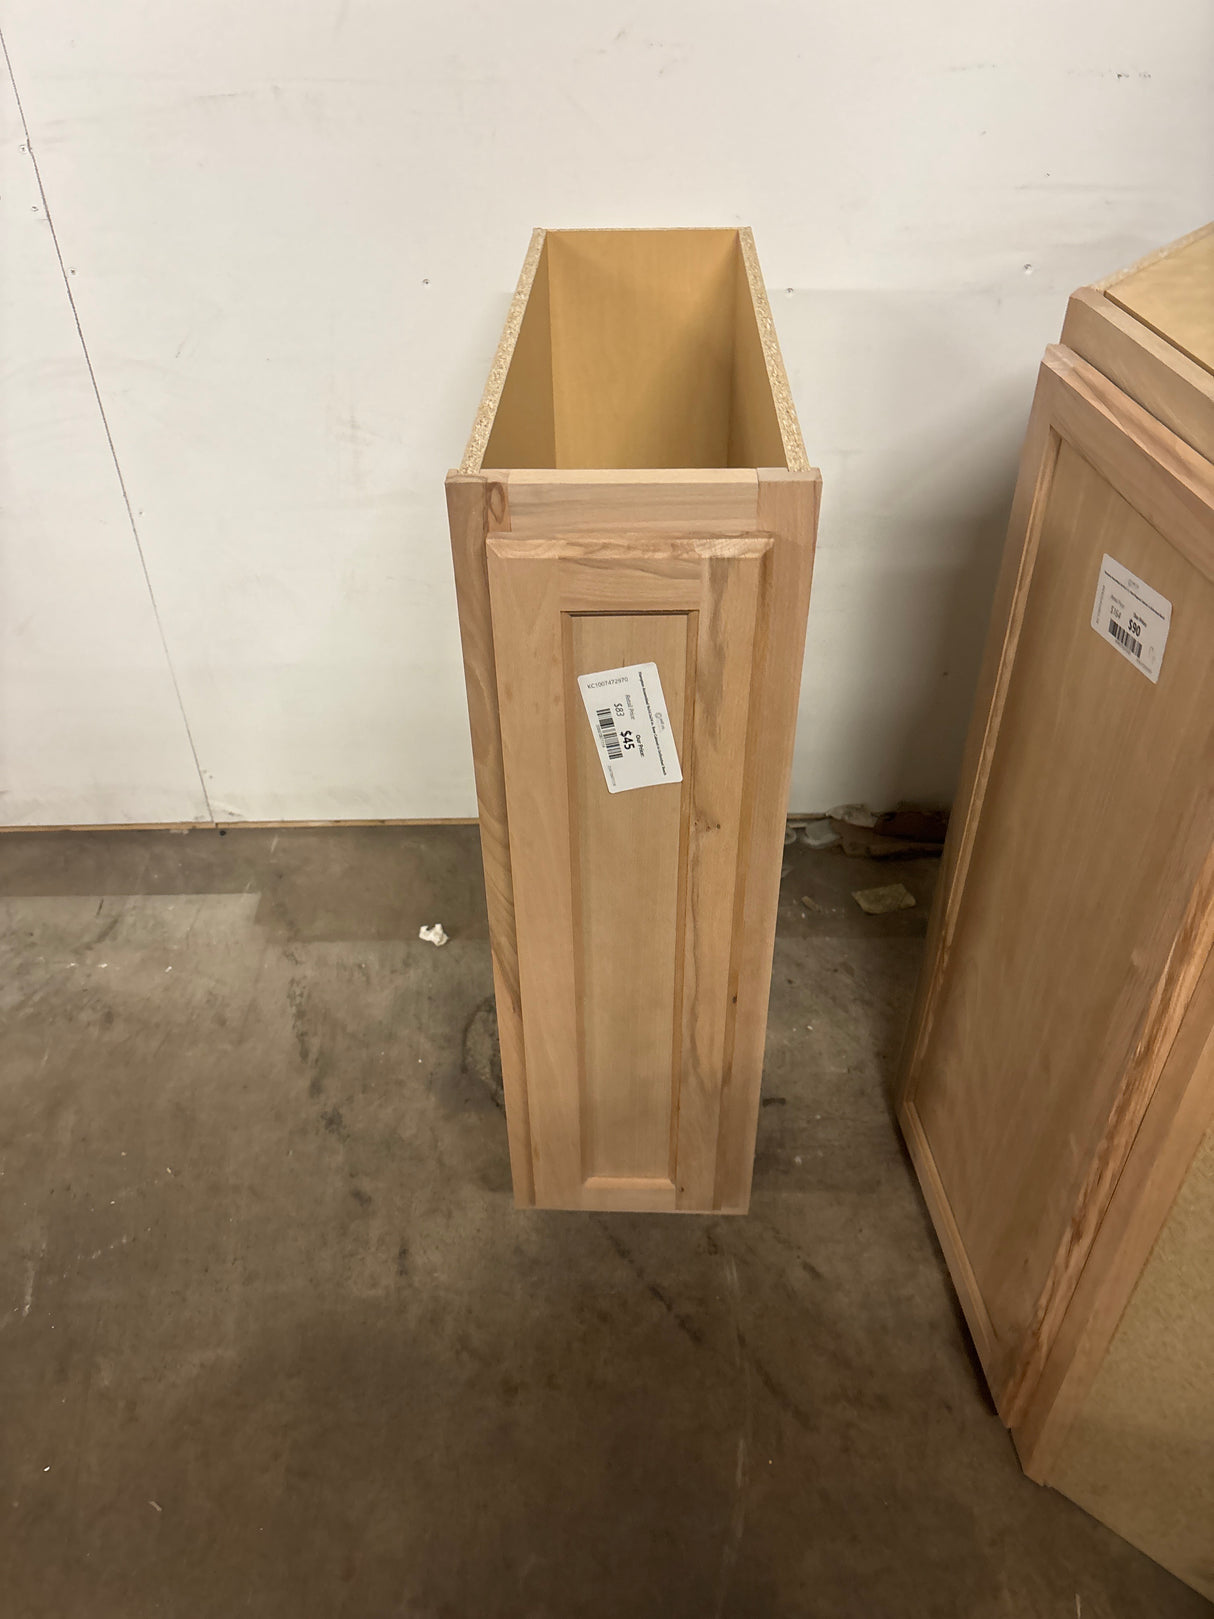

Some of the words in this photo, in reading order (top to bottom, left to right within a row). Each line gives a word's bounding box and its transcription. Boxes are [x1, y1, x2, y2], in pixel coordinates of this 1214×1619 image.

[1128, 619, 1141, 637] $90
[587, 677, 628, 688] KC1007472970
[613, 703, 625, 717] $83
[620, 730, 634, 750] $45
